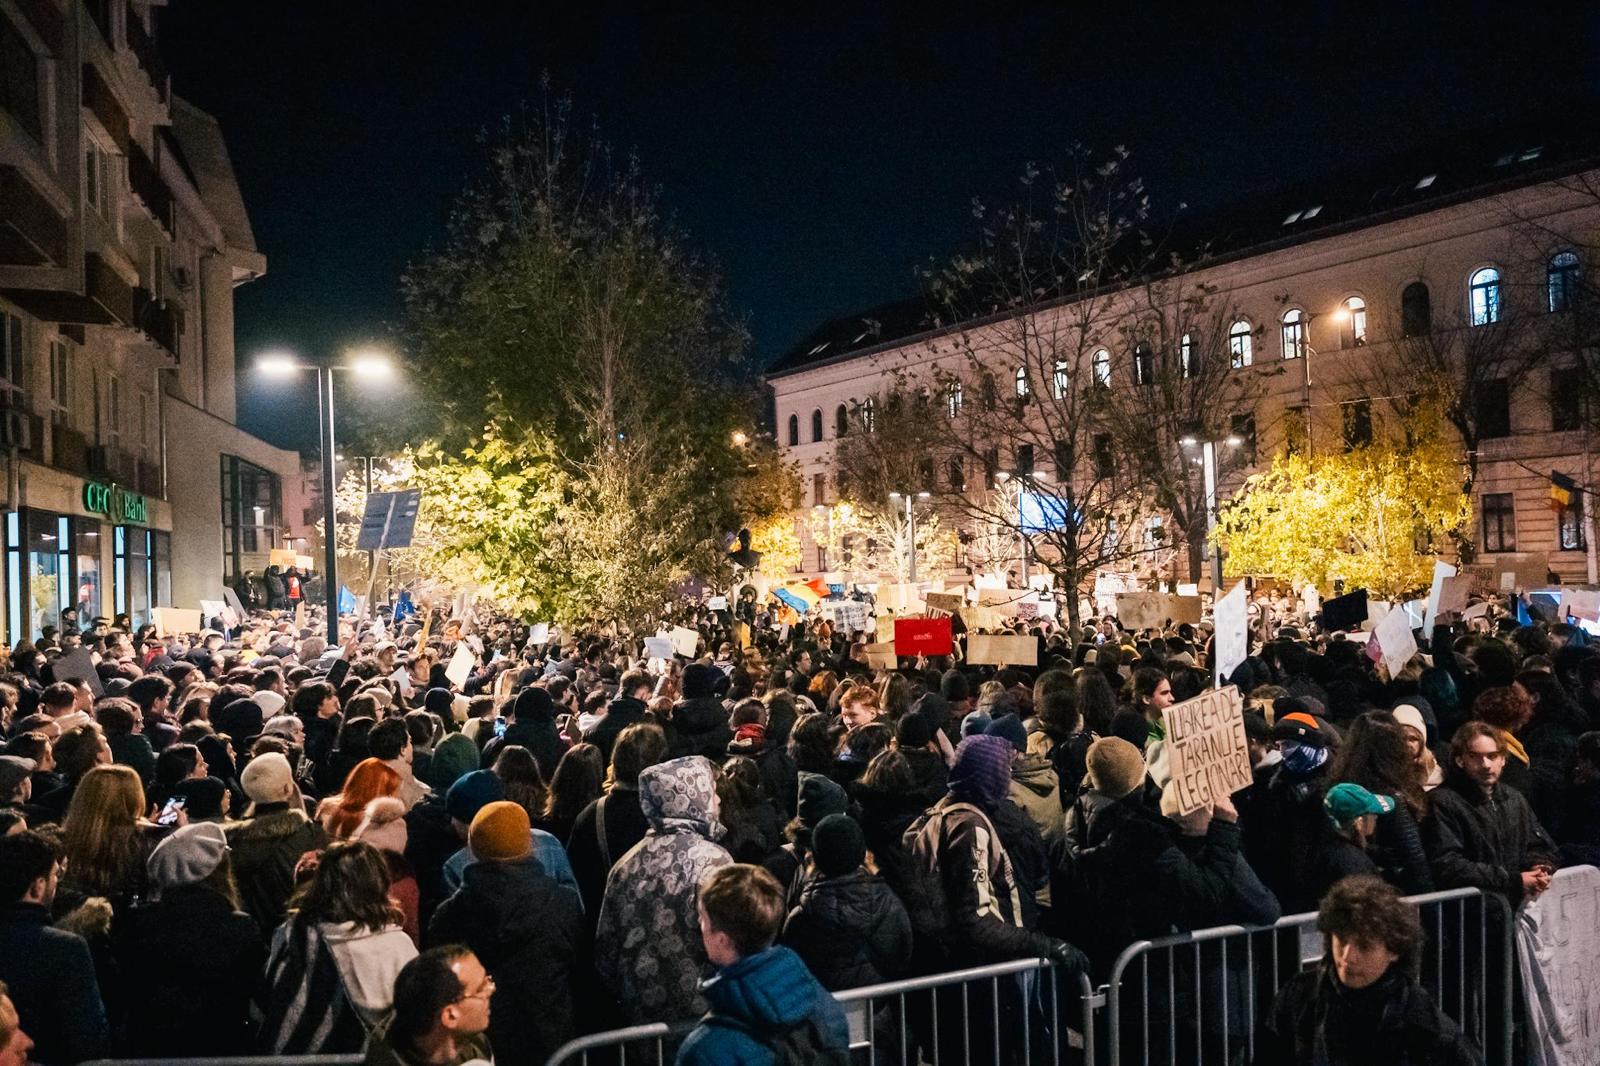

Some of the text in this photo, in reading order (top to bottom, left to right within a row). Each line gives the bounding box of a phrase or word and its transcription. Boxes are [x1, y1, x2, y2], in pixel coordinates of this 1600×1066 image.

[86, 484, 146, 520] CEC Bank
[1220, 688, 1242, 723] DE
[971, 868, 987, 882] 73
